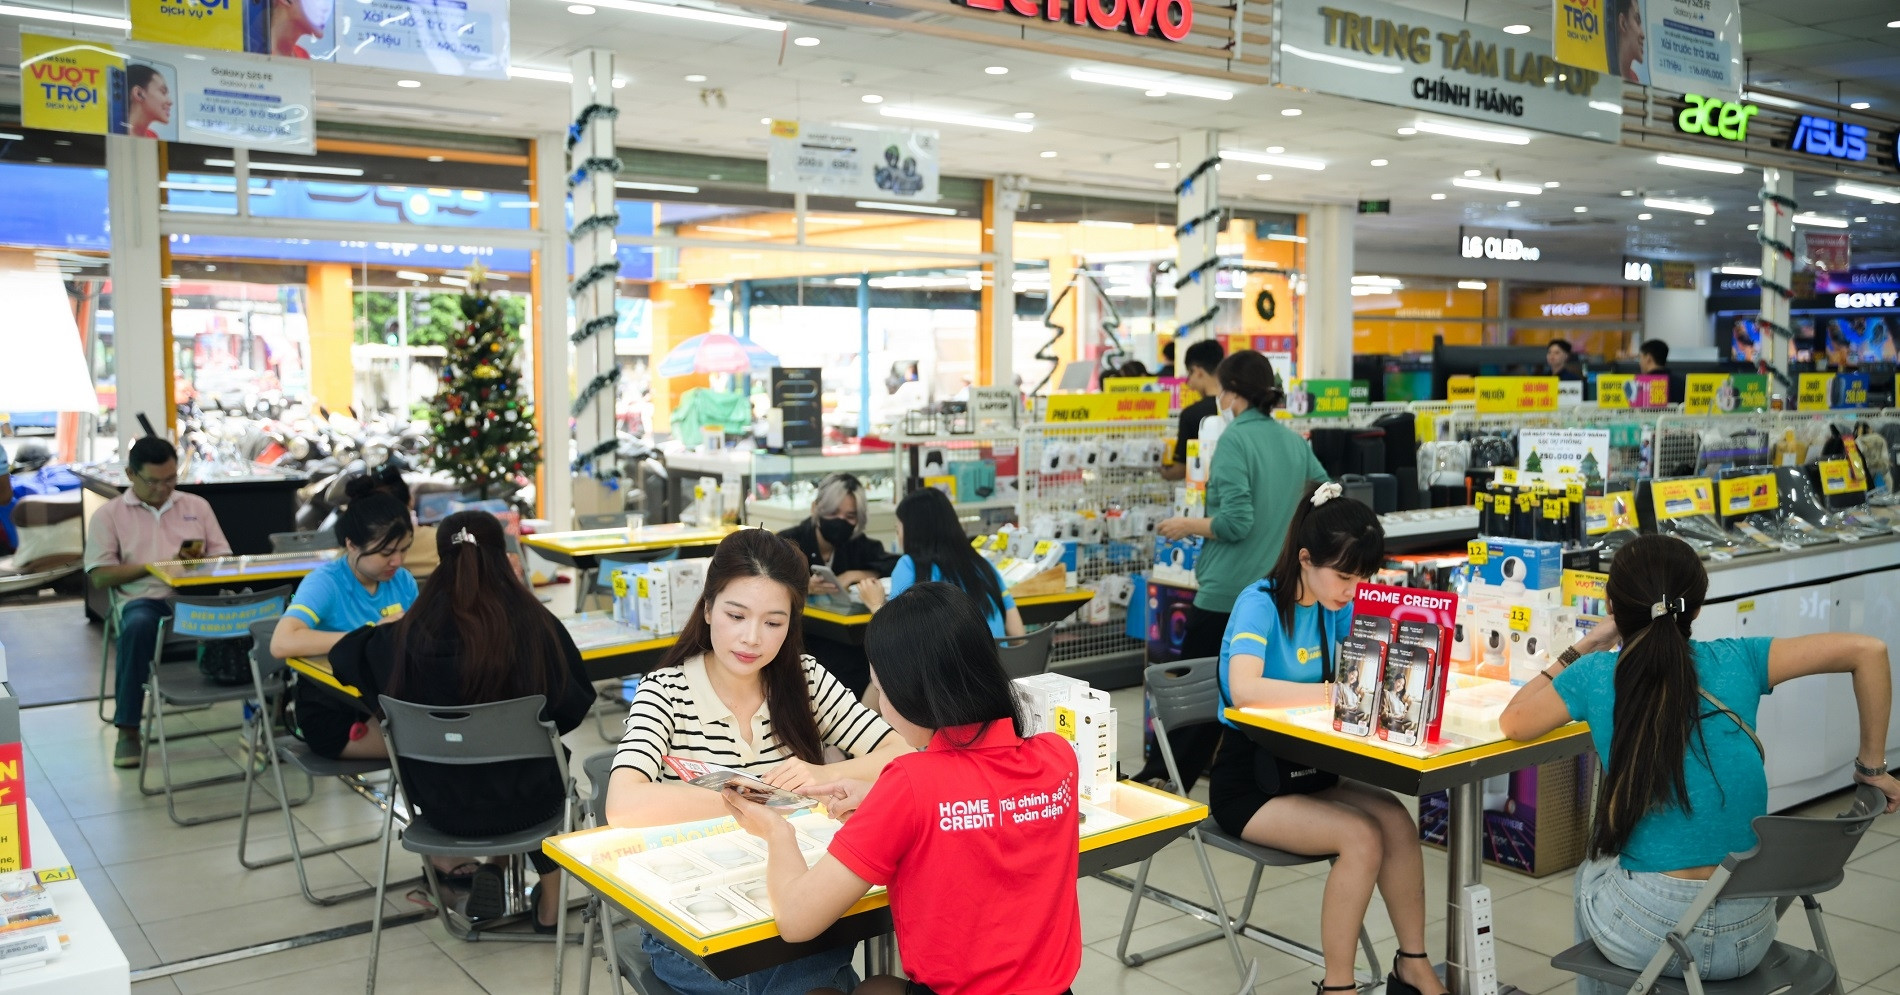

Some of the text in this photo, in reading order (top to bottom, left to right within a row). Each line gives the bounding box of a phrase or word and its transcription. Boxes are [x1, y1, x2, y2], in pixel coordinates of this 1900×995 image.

[967, 0, 1194, 42] novo
[1319, 6, 1432, 65] TRUNG
[1437, 29, 1499, 78] TÂM
[1411, 75, 1470, 107] CHÍNH
[1679, 93, 1760, 142] acer
[1793, 114, 1869, 161] ASUS
[1462, 236, 1484, 258] LG
[1485, 236, 1524, 261] OLED
[1624, 262, 1641, 282] LG
[1852, 272, 1899, 285] BRAVIA
[1721, 278, 1756, 291] SONY
[1835, 292, 1899, 309] SONY
[979, 401, 1009, 411] LAPTOP
[1053, 407, 1090, 421] PHỤ KIỆN
[1359, 588, 1452, 611] HOME CREDIT
[0, 759, 17, 781] N
[939, 799, 990, 818] HOME
[1000, 786, 1063, 812] Tài chính số
[940, 813, 995, 832] CREDIT
[1013, 803, 1064, 824] toàn diện
